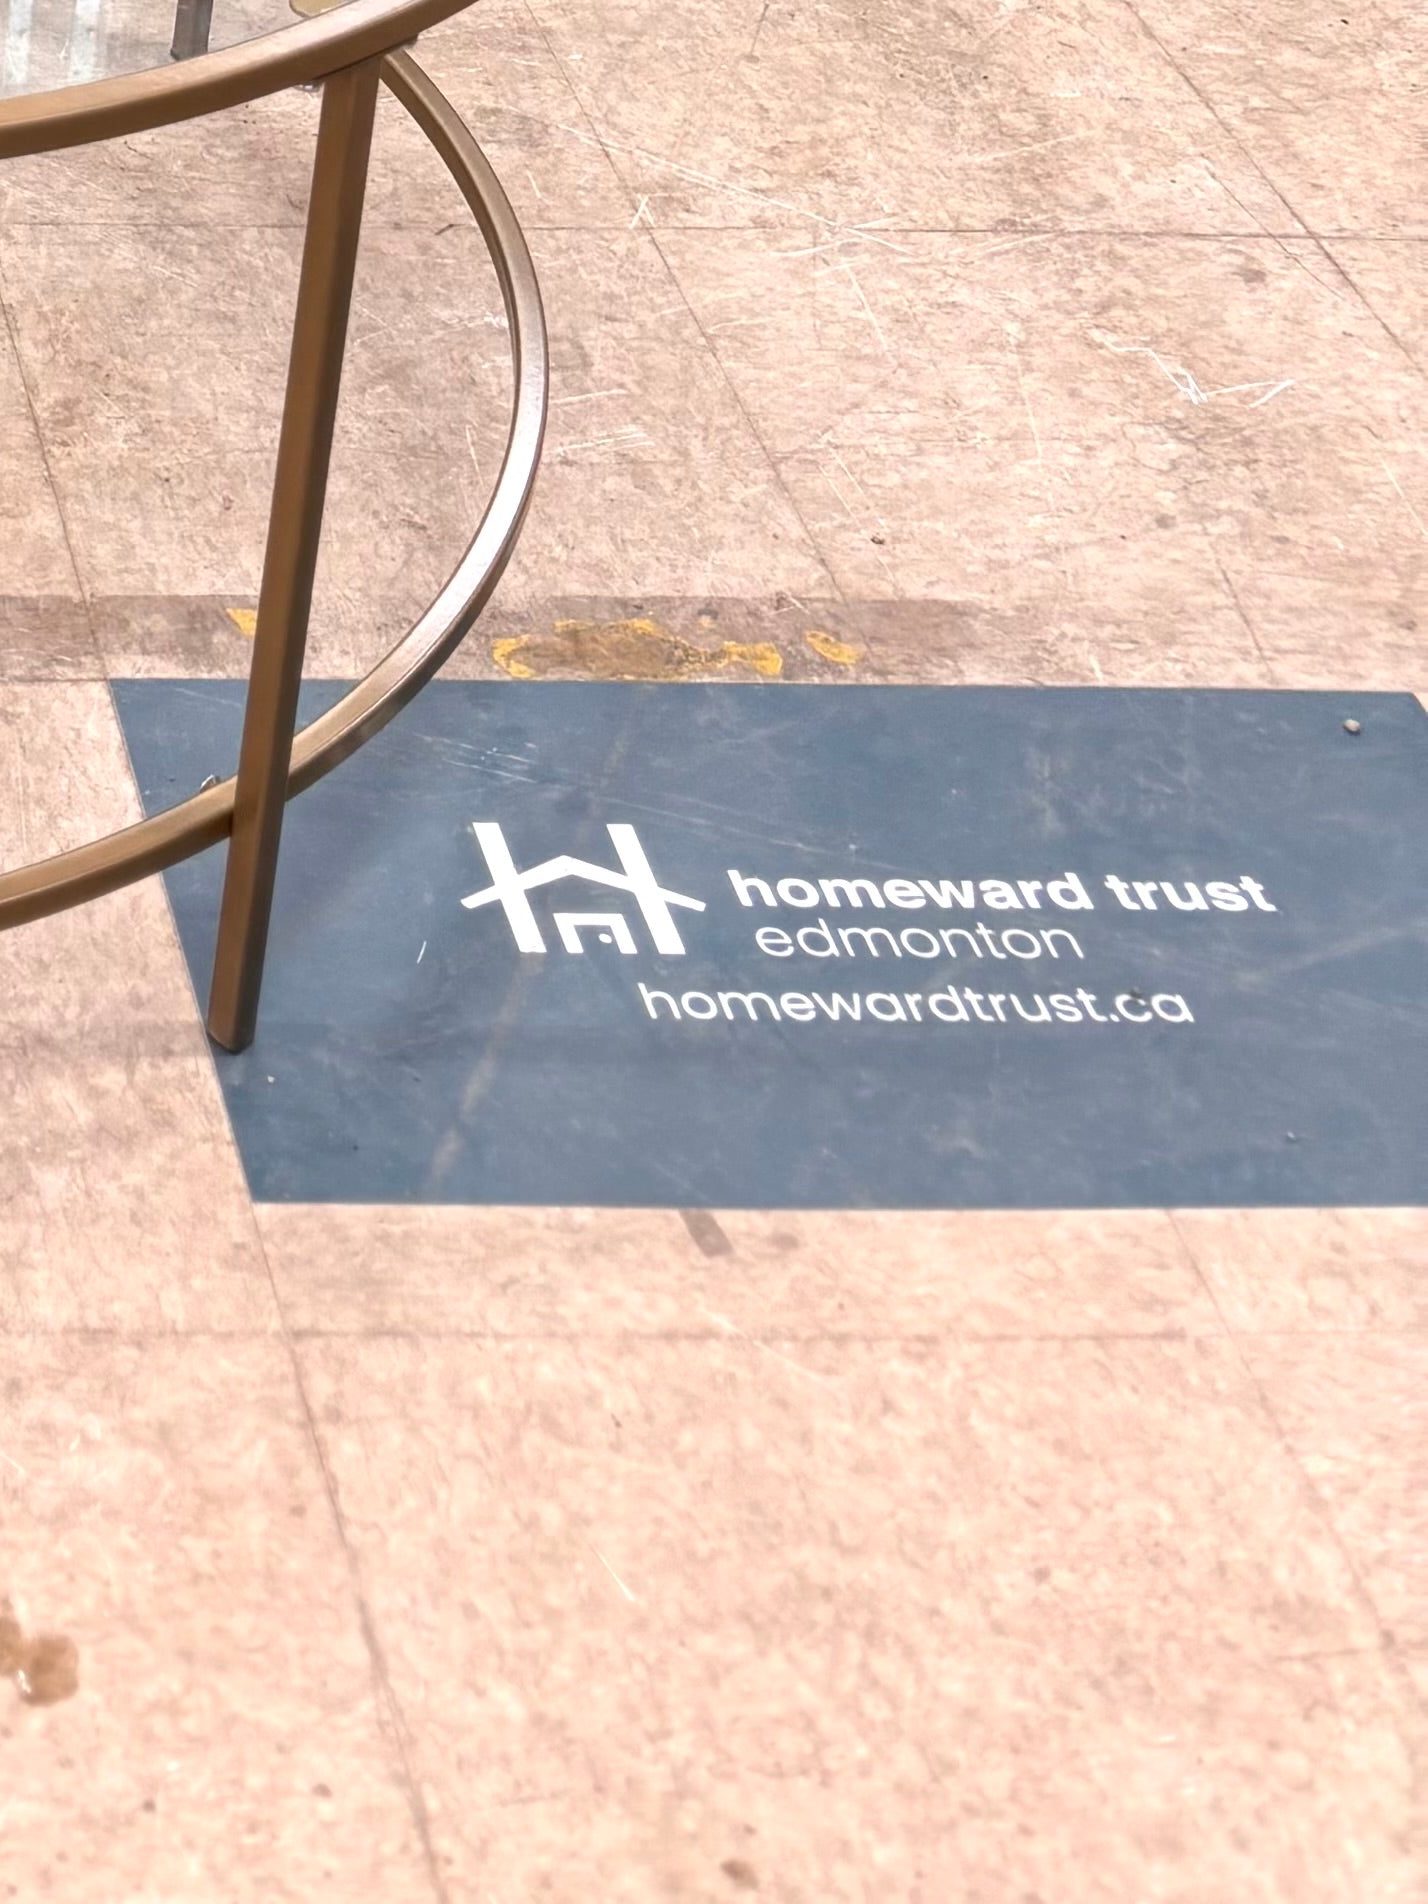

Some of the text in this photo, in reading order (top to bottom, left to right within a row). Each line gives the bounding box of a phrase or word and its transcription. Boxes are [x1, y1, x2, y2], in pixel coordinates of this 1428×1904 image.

[729, 869, 1276, 913] homeward trust
[756, 919, 1083, 959] edmonton
[639, 981, 1194, 1024] homewardtrust.ca
